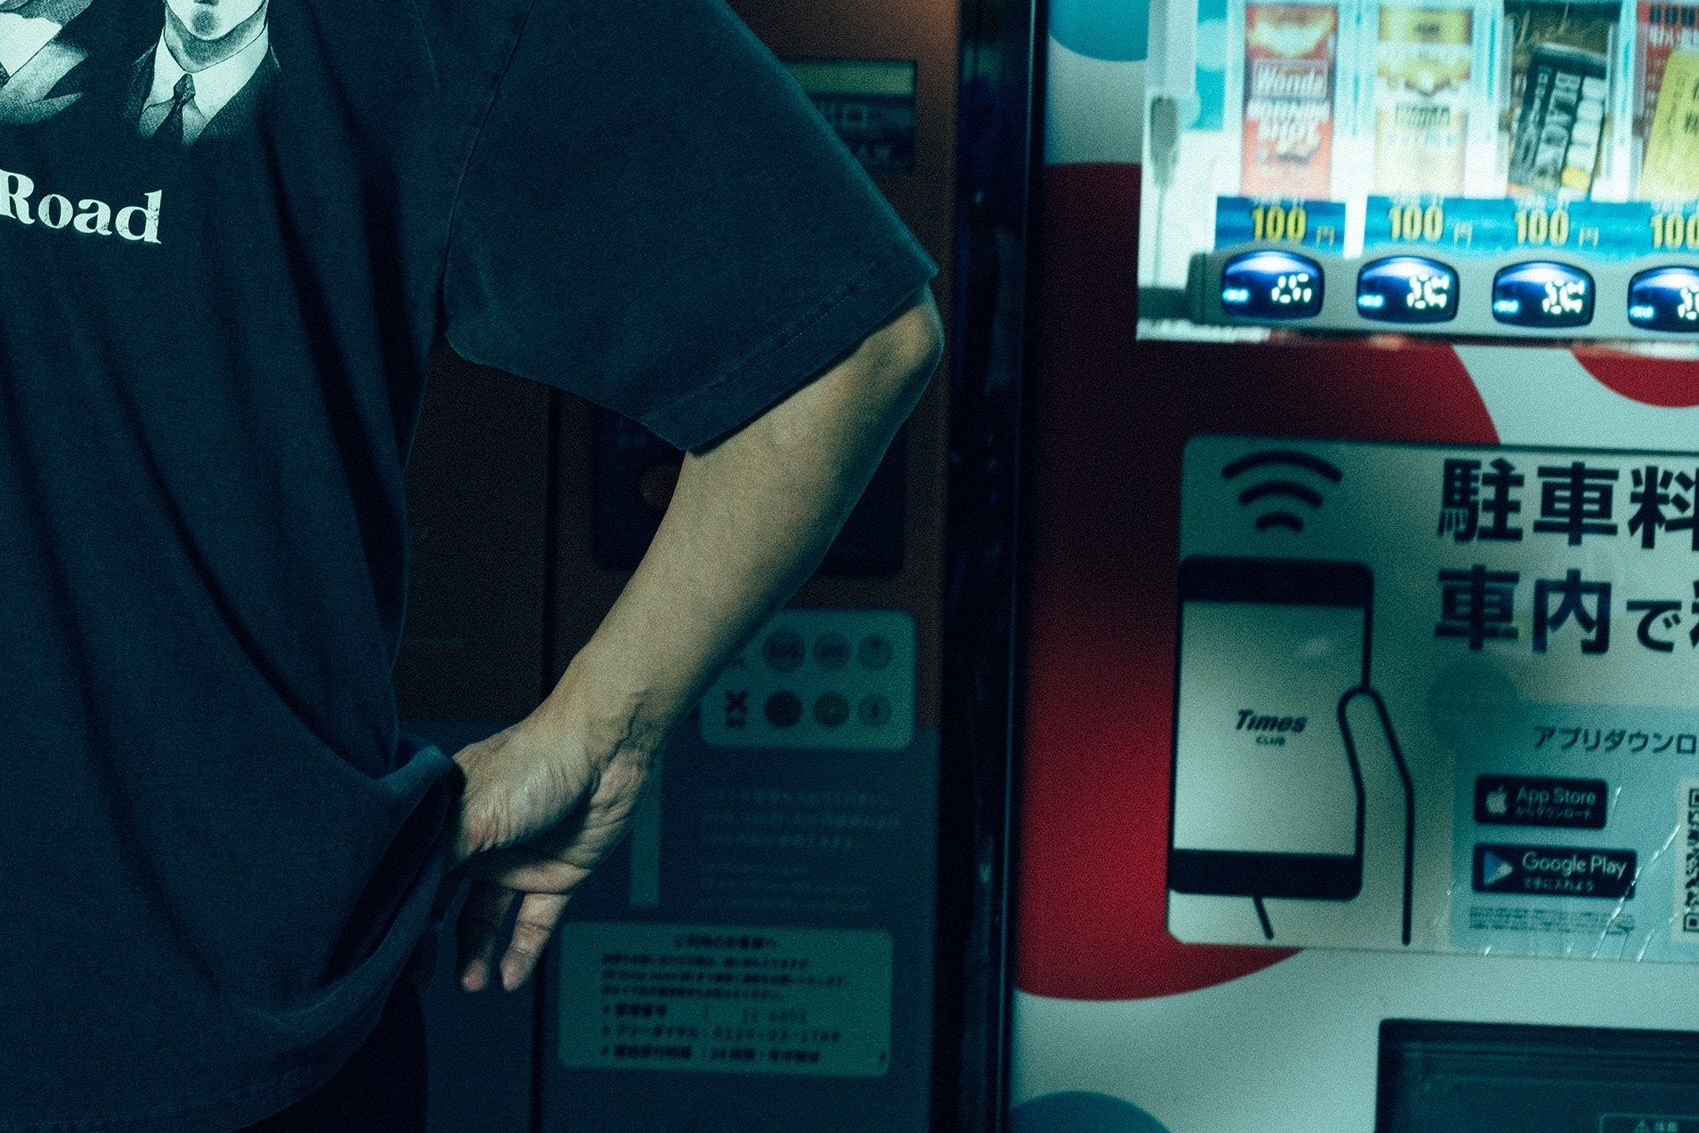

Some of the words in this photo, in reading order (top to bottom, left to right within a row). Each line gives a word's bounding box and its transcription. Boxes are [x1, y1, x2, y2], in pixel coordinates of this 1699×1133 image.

[1251, 206, 1307, 241] 100
[1389, 206, 1443, 241] 100
[1514, 209, 1570, 245] 100
[1434, 560, 1699, 656] 車内で
[1235, 708, 1309, 733] Times
[1255, 735, 1287, 747] CLUB
[1515, 785, 1551, 807] App
[1552, 785, 1597, 807] Store
[1521, 850, 1587, 877] Google
[1589, 854, 1628, 881] Play
